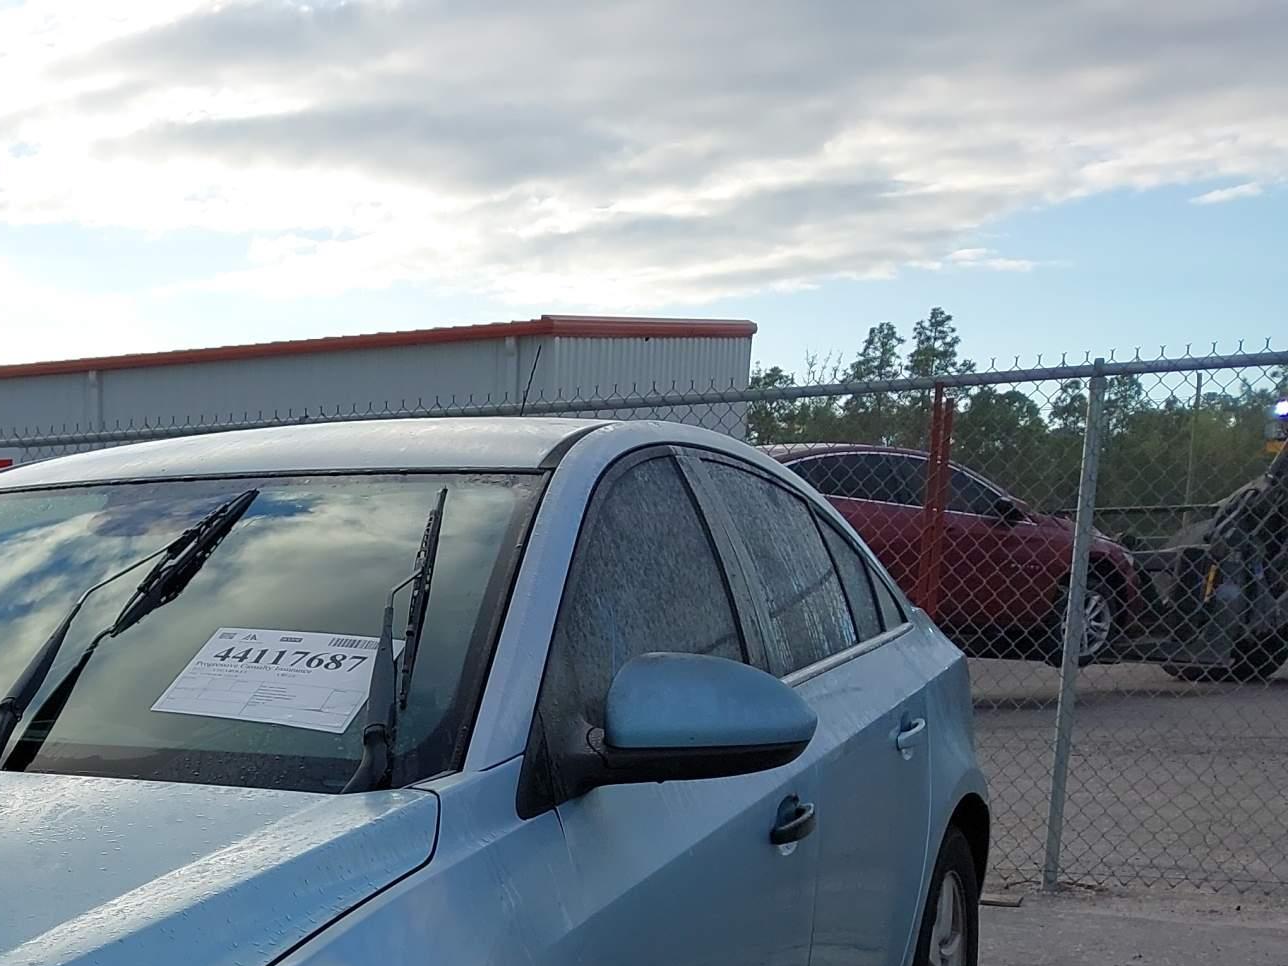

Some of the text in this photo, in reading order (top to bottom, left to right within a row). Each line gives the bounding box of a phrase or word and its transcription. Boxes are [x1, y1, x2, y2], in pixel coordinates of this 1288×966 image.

[214, 646, 368, 672] 44117687
[240, 662, 272, 671] Casualty
[274, 665, 312, 674] Insurance
